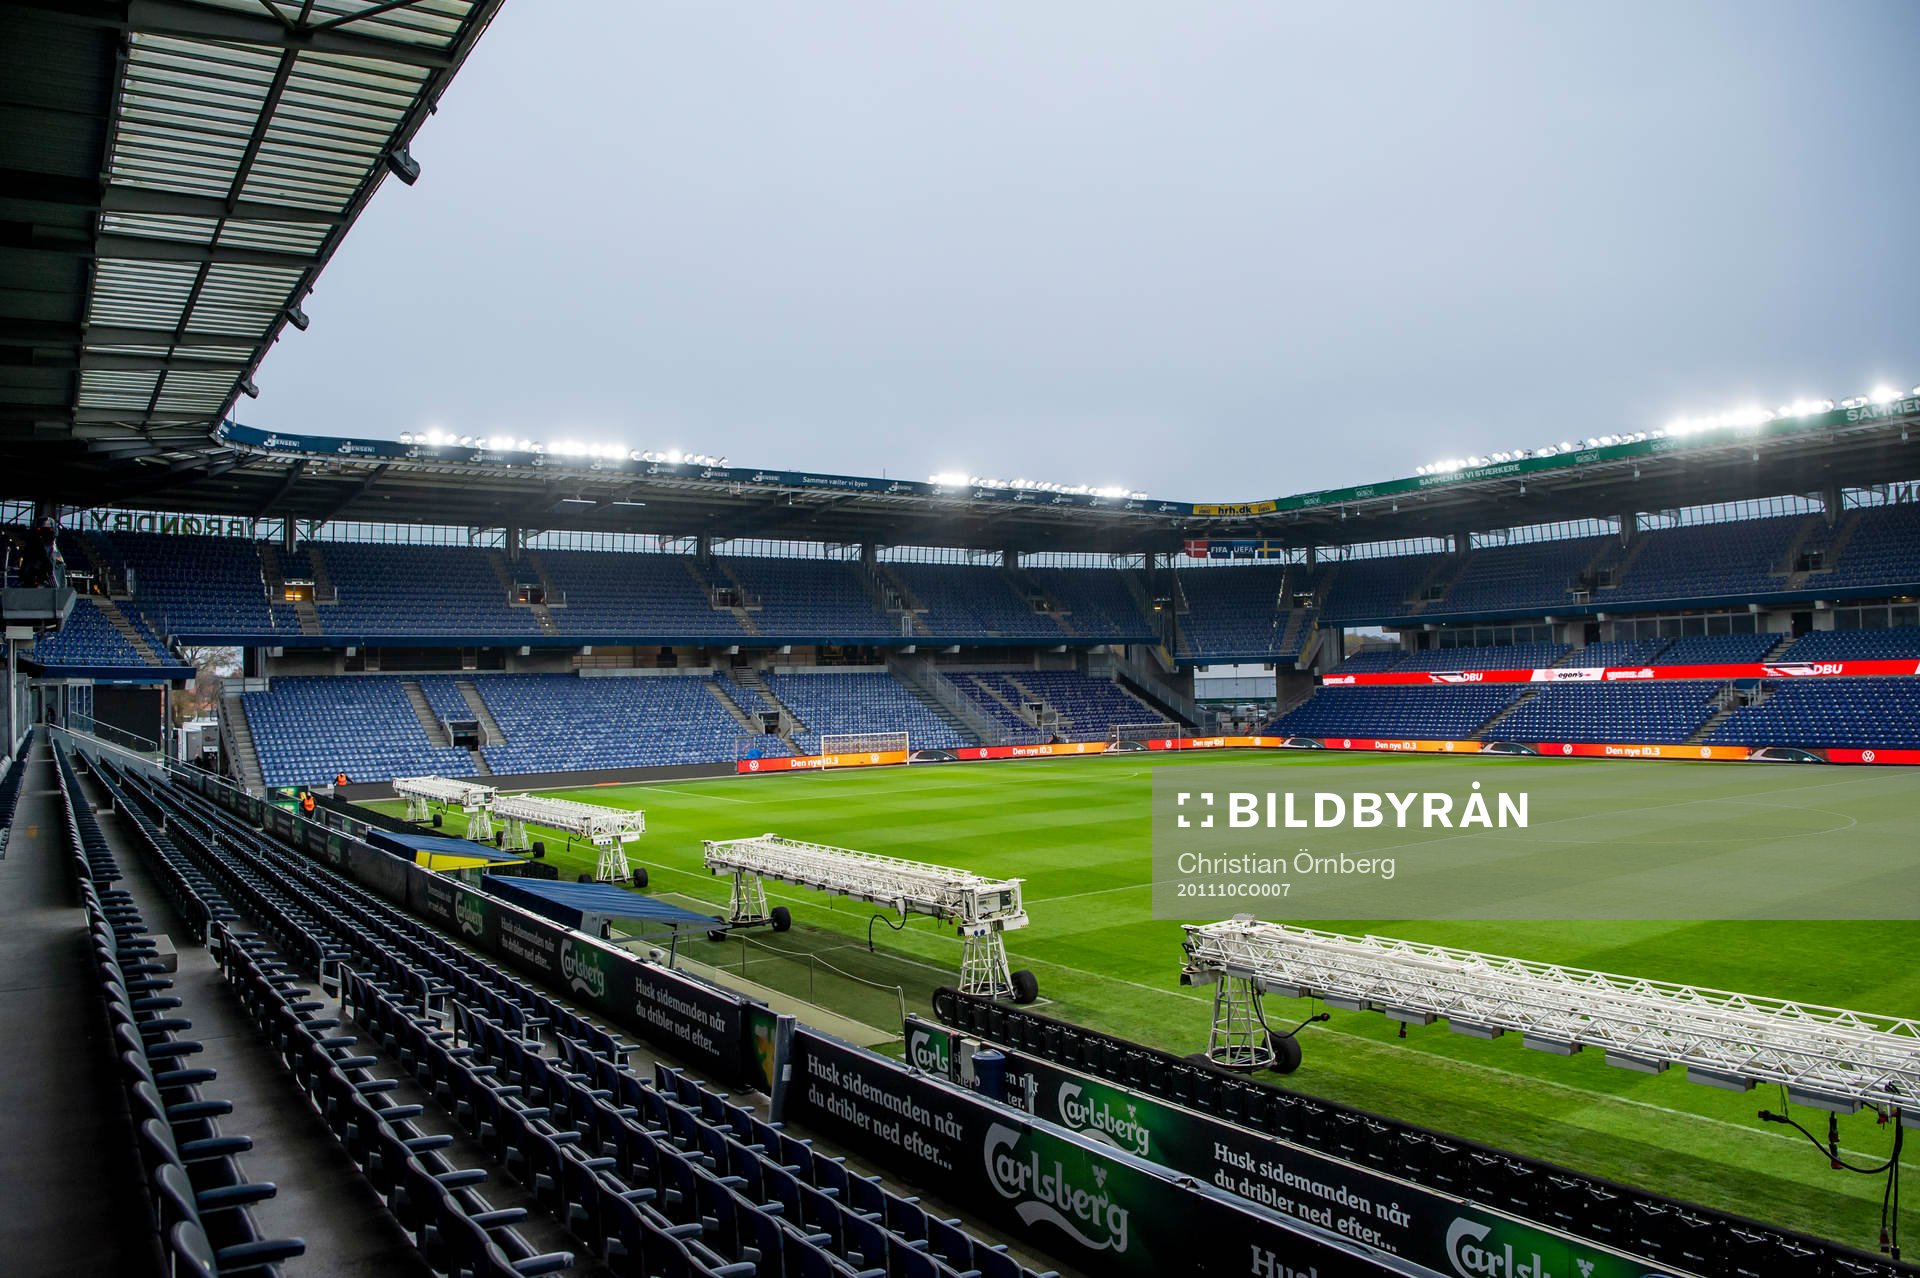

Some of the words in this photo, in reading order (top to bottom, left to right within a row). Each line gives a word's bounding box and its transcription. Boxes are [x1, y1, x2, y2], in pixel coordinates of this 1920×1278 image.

[802, 476, 828, 485] Sammen
[854, 480, 868, 488] byen
[1420, 475, 1453, 486] SAMMEN
[1454, 472, 1465, 481] ER
[1218, 506, 1252, 515] hrh.dk
[1211, 546, 1228, 554] FIFA
[1233, 546, 1254, 554] UEFA
[1462, 672, 1483, 682] DBU
[1813, 664, 1843, 675] DBU
[791, 759, 806, 767] Den
[560, 939, 605, 996] Carlsberg
[635, 977, 655, 1000] Husk
[656, 986, 708, 1025] sidemanden
[709, 1011, 726, 1033] når
[636, 1002, 646, 1018] du
[647, 1005, 674, 1033] dribler
[675, 1023, 691, 1041] ned
[911, 1030, 948, 1074] Carls
[807, 1053, 840, 1086] Husk
[842, 1072, 931, 1128] sidemanden
[934, 1112, 963, 1141] når
[808, 1083, 825, 1108] du
[826, 1092, 871, 1131] dribler
[873, 1118, 901, 1146] ned
[903, 1130, 953, 1171] efter...
[1058, 1081, 1150, 1156] Carlsberg
[983, 1122, 1130, 1253] Carlsberg
[1214, 1141, 1257, 1174] Husk
[1259, 1161, 1372, 1216] sidemanden
[1375, 1202, 1411, 1229] når
[1214, 1169, 1236, 1192] du
[1239, 1177, 1295, 1214] dribler
[1298, 1202, 1332, 1229] ned
[1337, 1217, 1398, 1253] efter...
